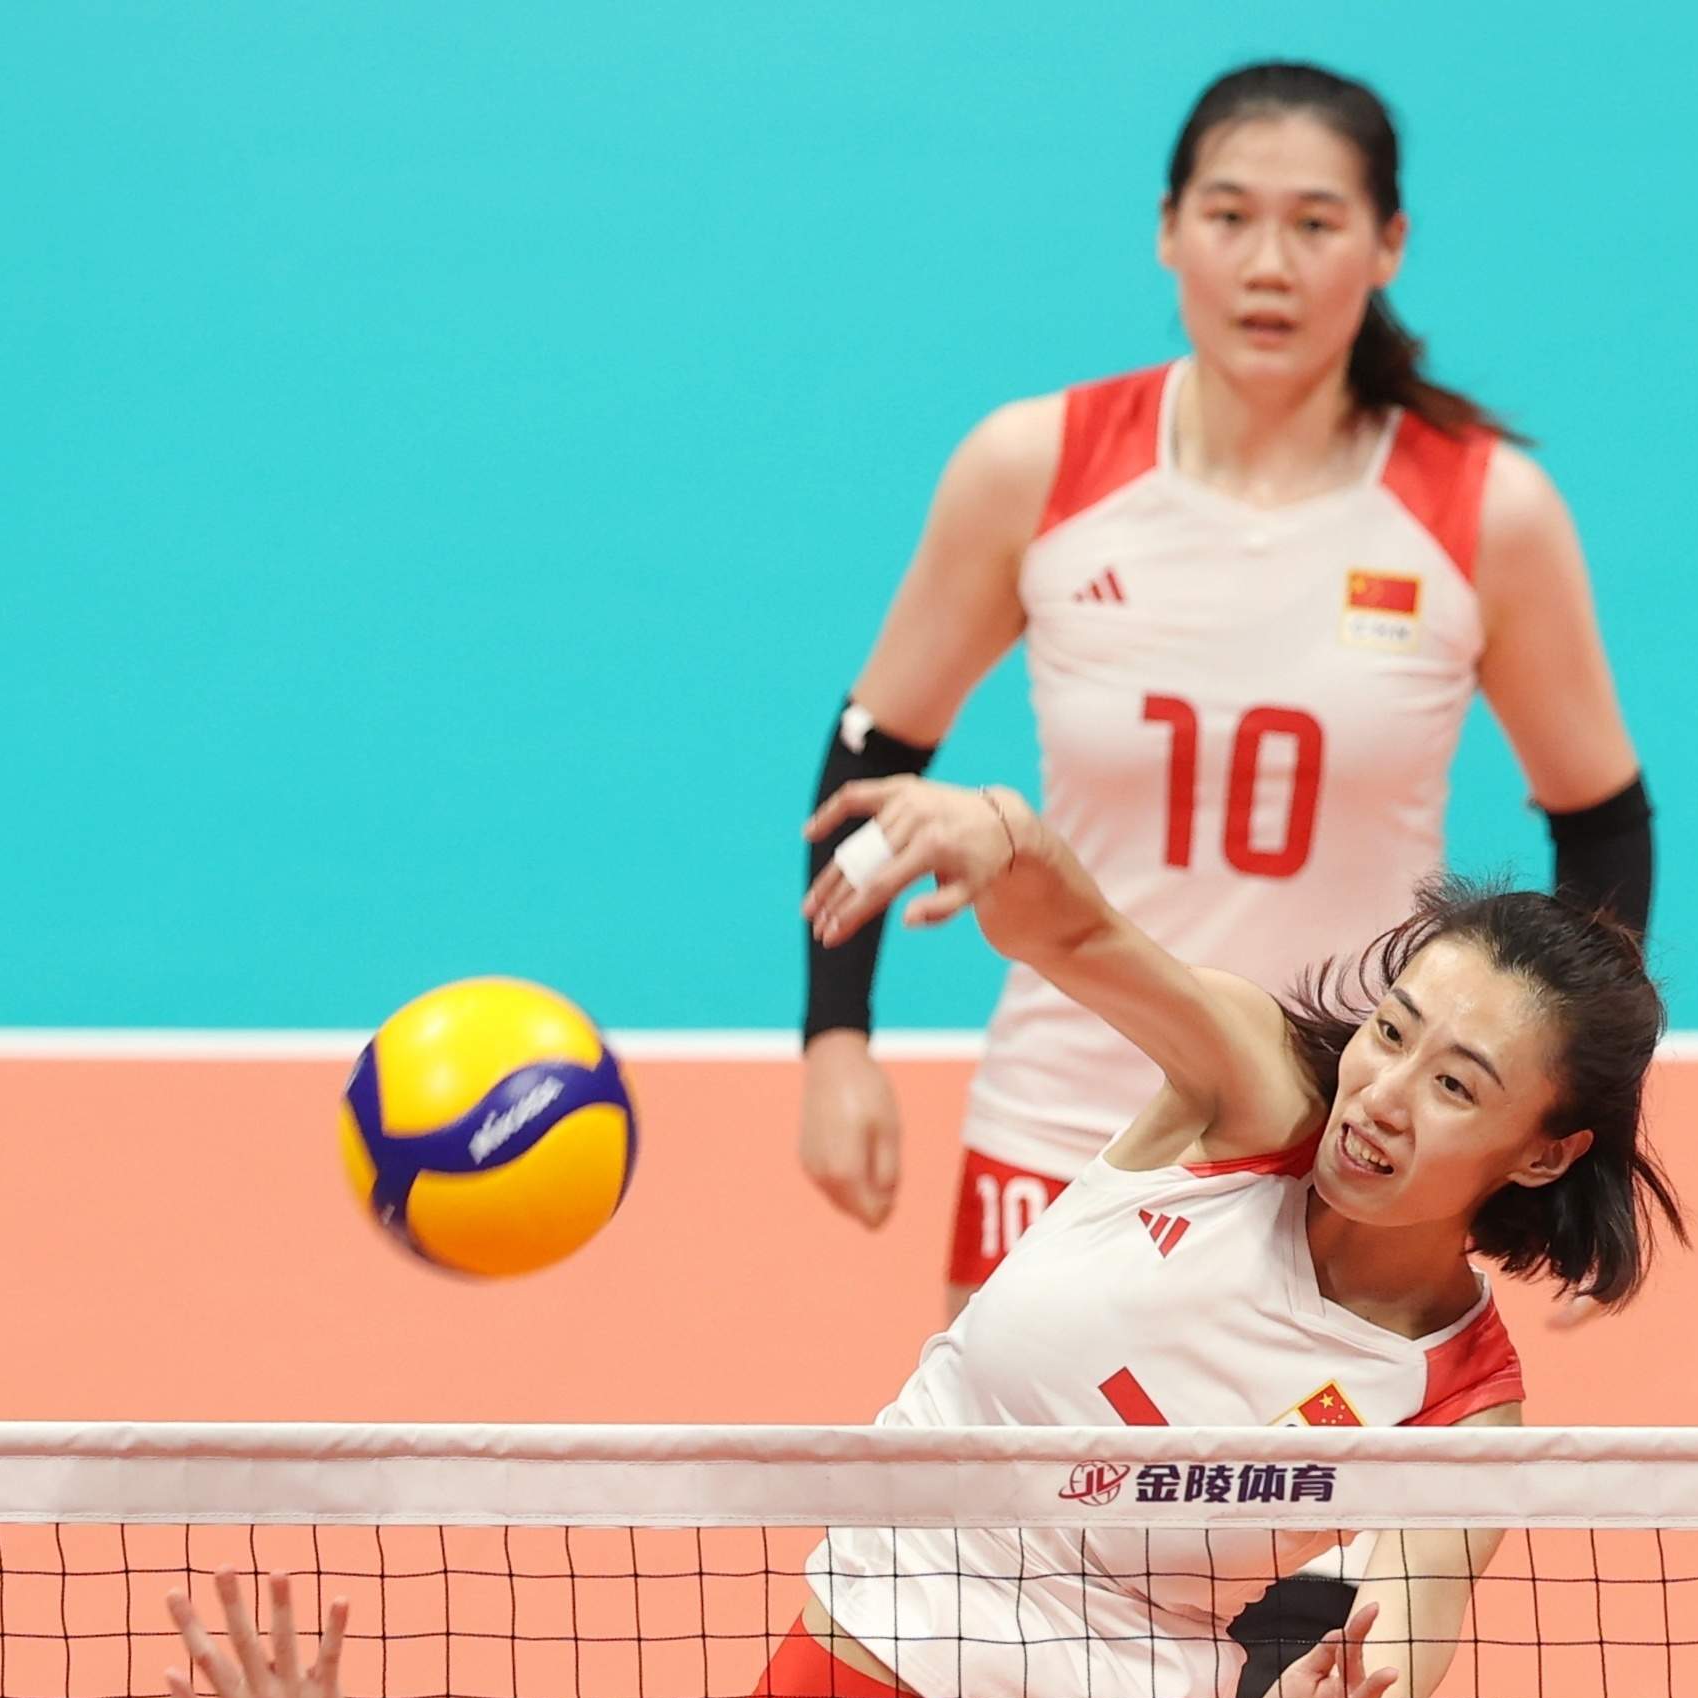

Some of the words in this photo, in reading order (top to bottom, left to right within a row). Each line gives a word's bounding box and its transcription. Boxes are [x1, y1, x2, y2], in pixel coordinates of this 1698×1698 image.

[1141, 694, 1325, 879] 10
[975, 1174, 1049, 1260] 10
[1135, 1463, 1337, 1503] 金陵体育
